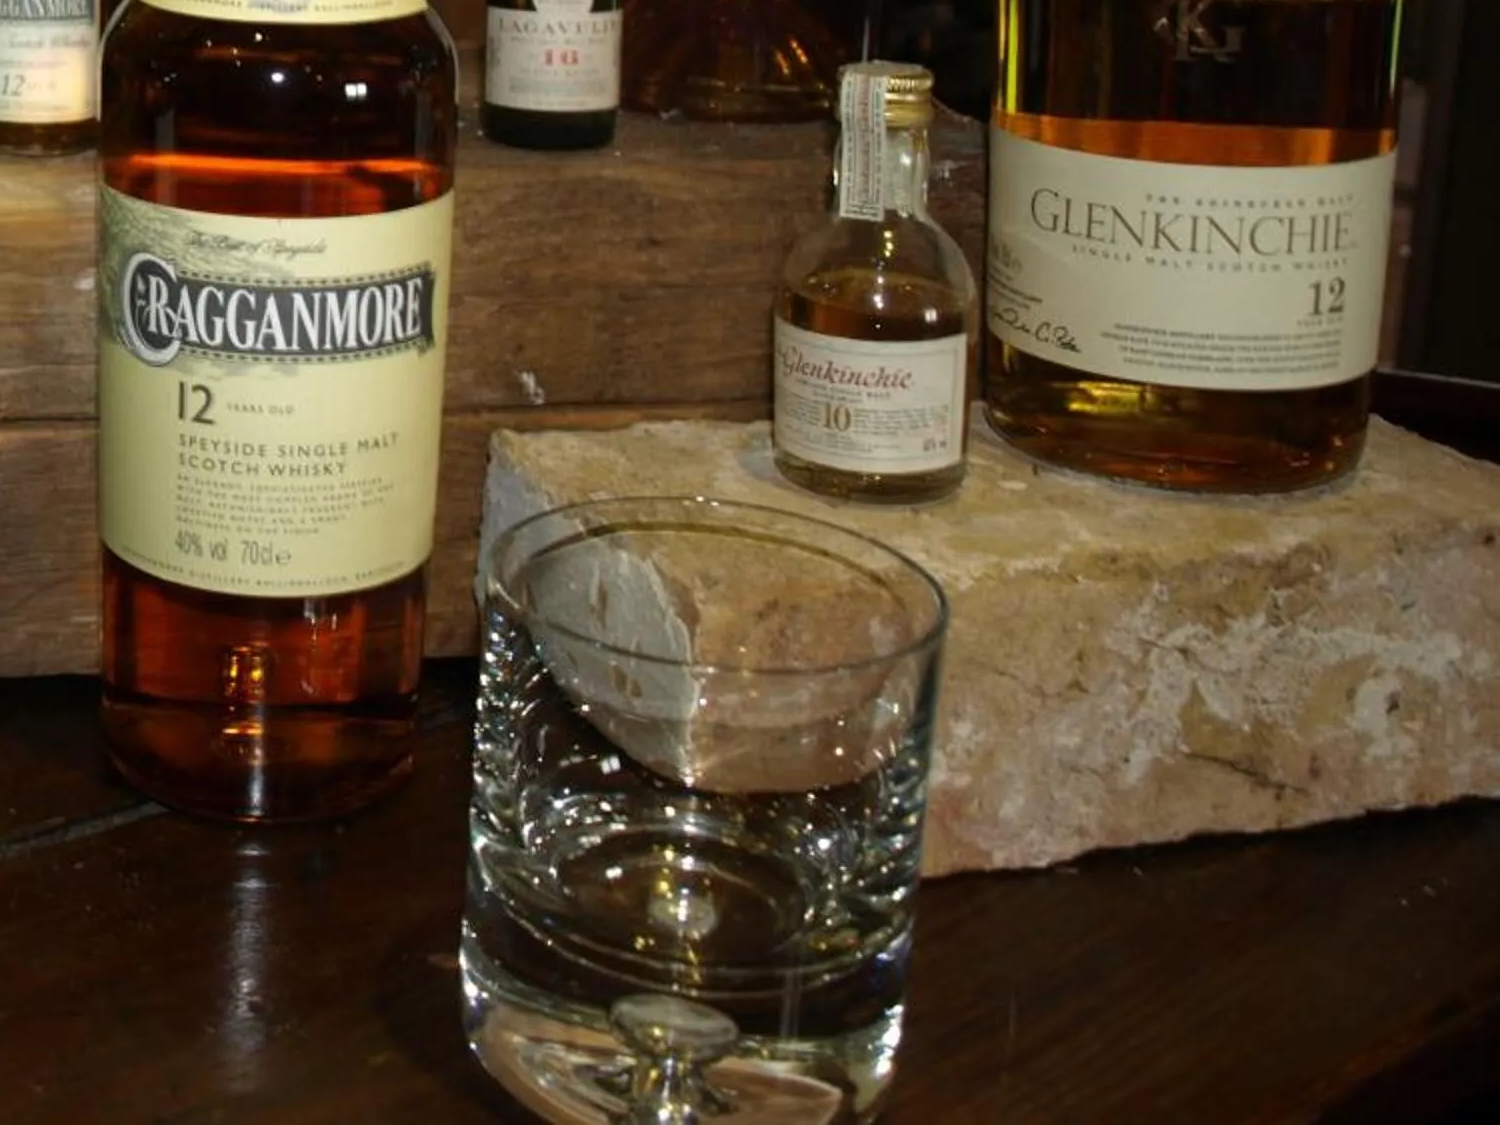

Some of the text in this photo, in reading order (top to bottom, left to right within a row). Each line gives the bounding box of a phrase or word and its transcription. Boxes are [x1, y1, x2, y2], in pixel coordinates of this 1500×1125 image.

[544, 48, 580, 67] 16
[1030, 188, 1358, 257] GLENKINCHIE
[122, 252, 424, 367] CRAGGANMORE
[1307, 276, 1346, 316] 12
[780, 345, 914, 390] Glenkinchie
[176, 380, 217, 425] 12
[268, 403, 296, 416] OLD
[822, 401, 852, 433] 10
[178, 431, 400, 458] SPEYSIDE SINGLE MALT
[178, 454, 347, 477] SCOTCH WHISKY
[174, 529, 204, 559] 40%
[208, 536, 229, 562] vol
[240, 538, 273, 567] 70cl
